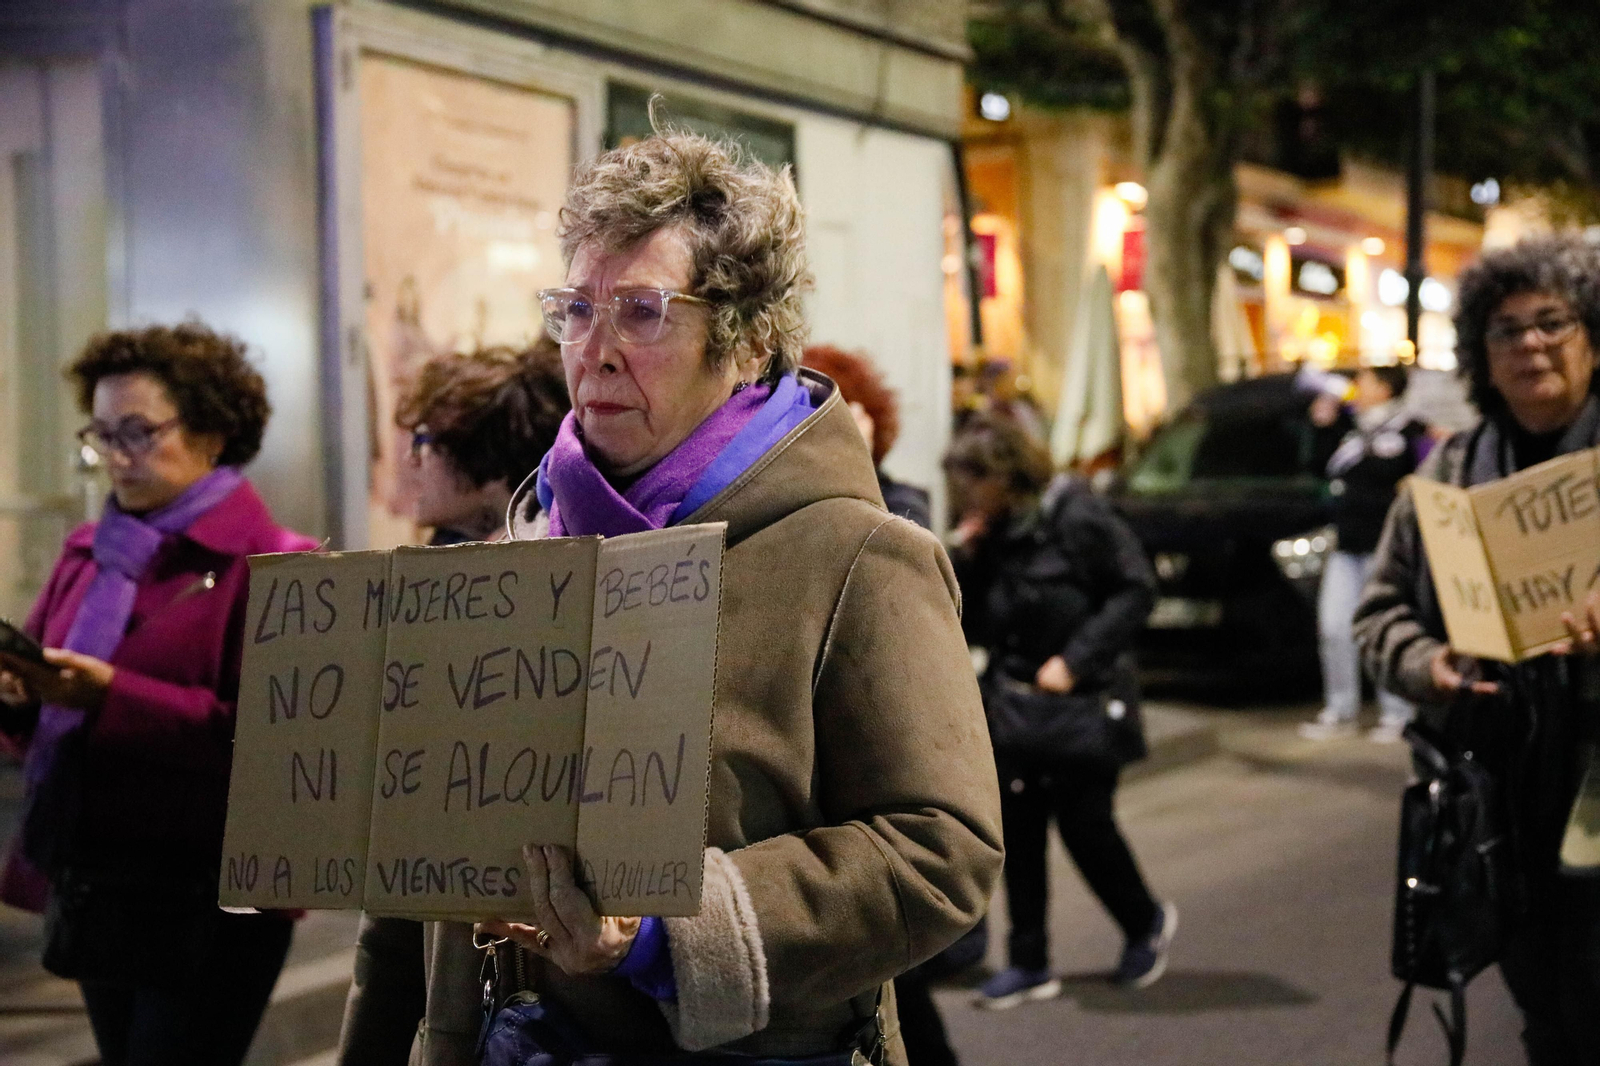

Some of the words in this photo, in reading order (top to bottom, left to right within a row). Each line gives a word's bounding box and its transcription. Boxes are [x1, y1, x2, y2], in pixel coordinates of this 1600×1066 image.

[1496, 470, 1600, 535] PUTE
[254, 577, 336, 643] LAS
[363, 571, 519, 630] MUJERES
[550, 571, 573, 620] Y
[600, 544, 710, 618] BEBÉS
[1501, 564, 1575, 614] HAY
[269, 664, 344, 724] NO
[383, 661, 425, 713] SE
[448, 641, 651, 710] VENDEN
[292, 749, 336, 803] NI
[381, 749, 426, 799] SE
[445, 734, 685, 811] ALQUILAN
[228, 853, 260, 892] NO
[273, 856, 292, 898] A
[314, 857, 355, 896] LOS
[376, 857, 521, 897] VIENTRES
[583, 858, 693, 901] ALQUILER
